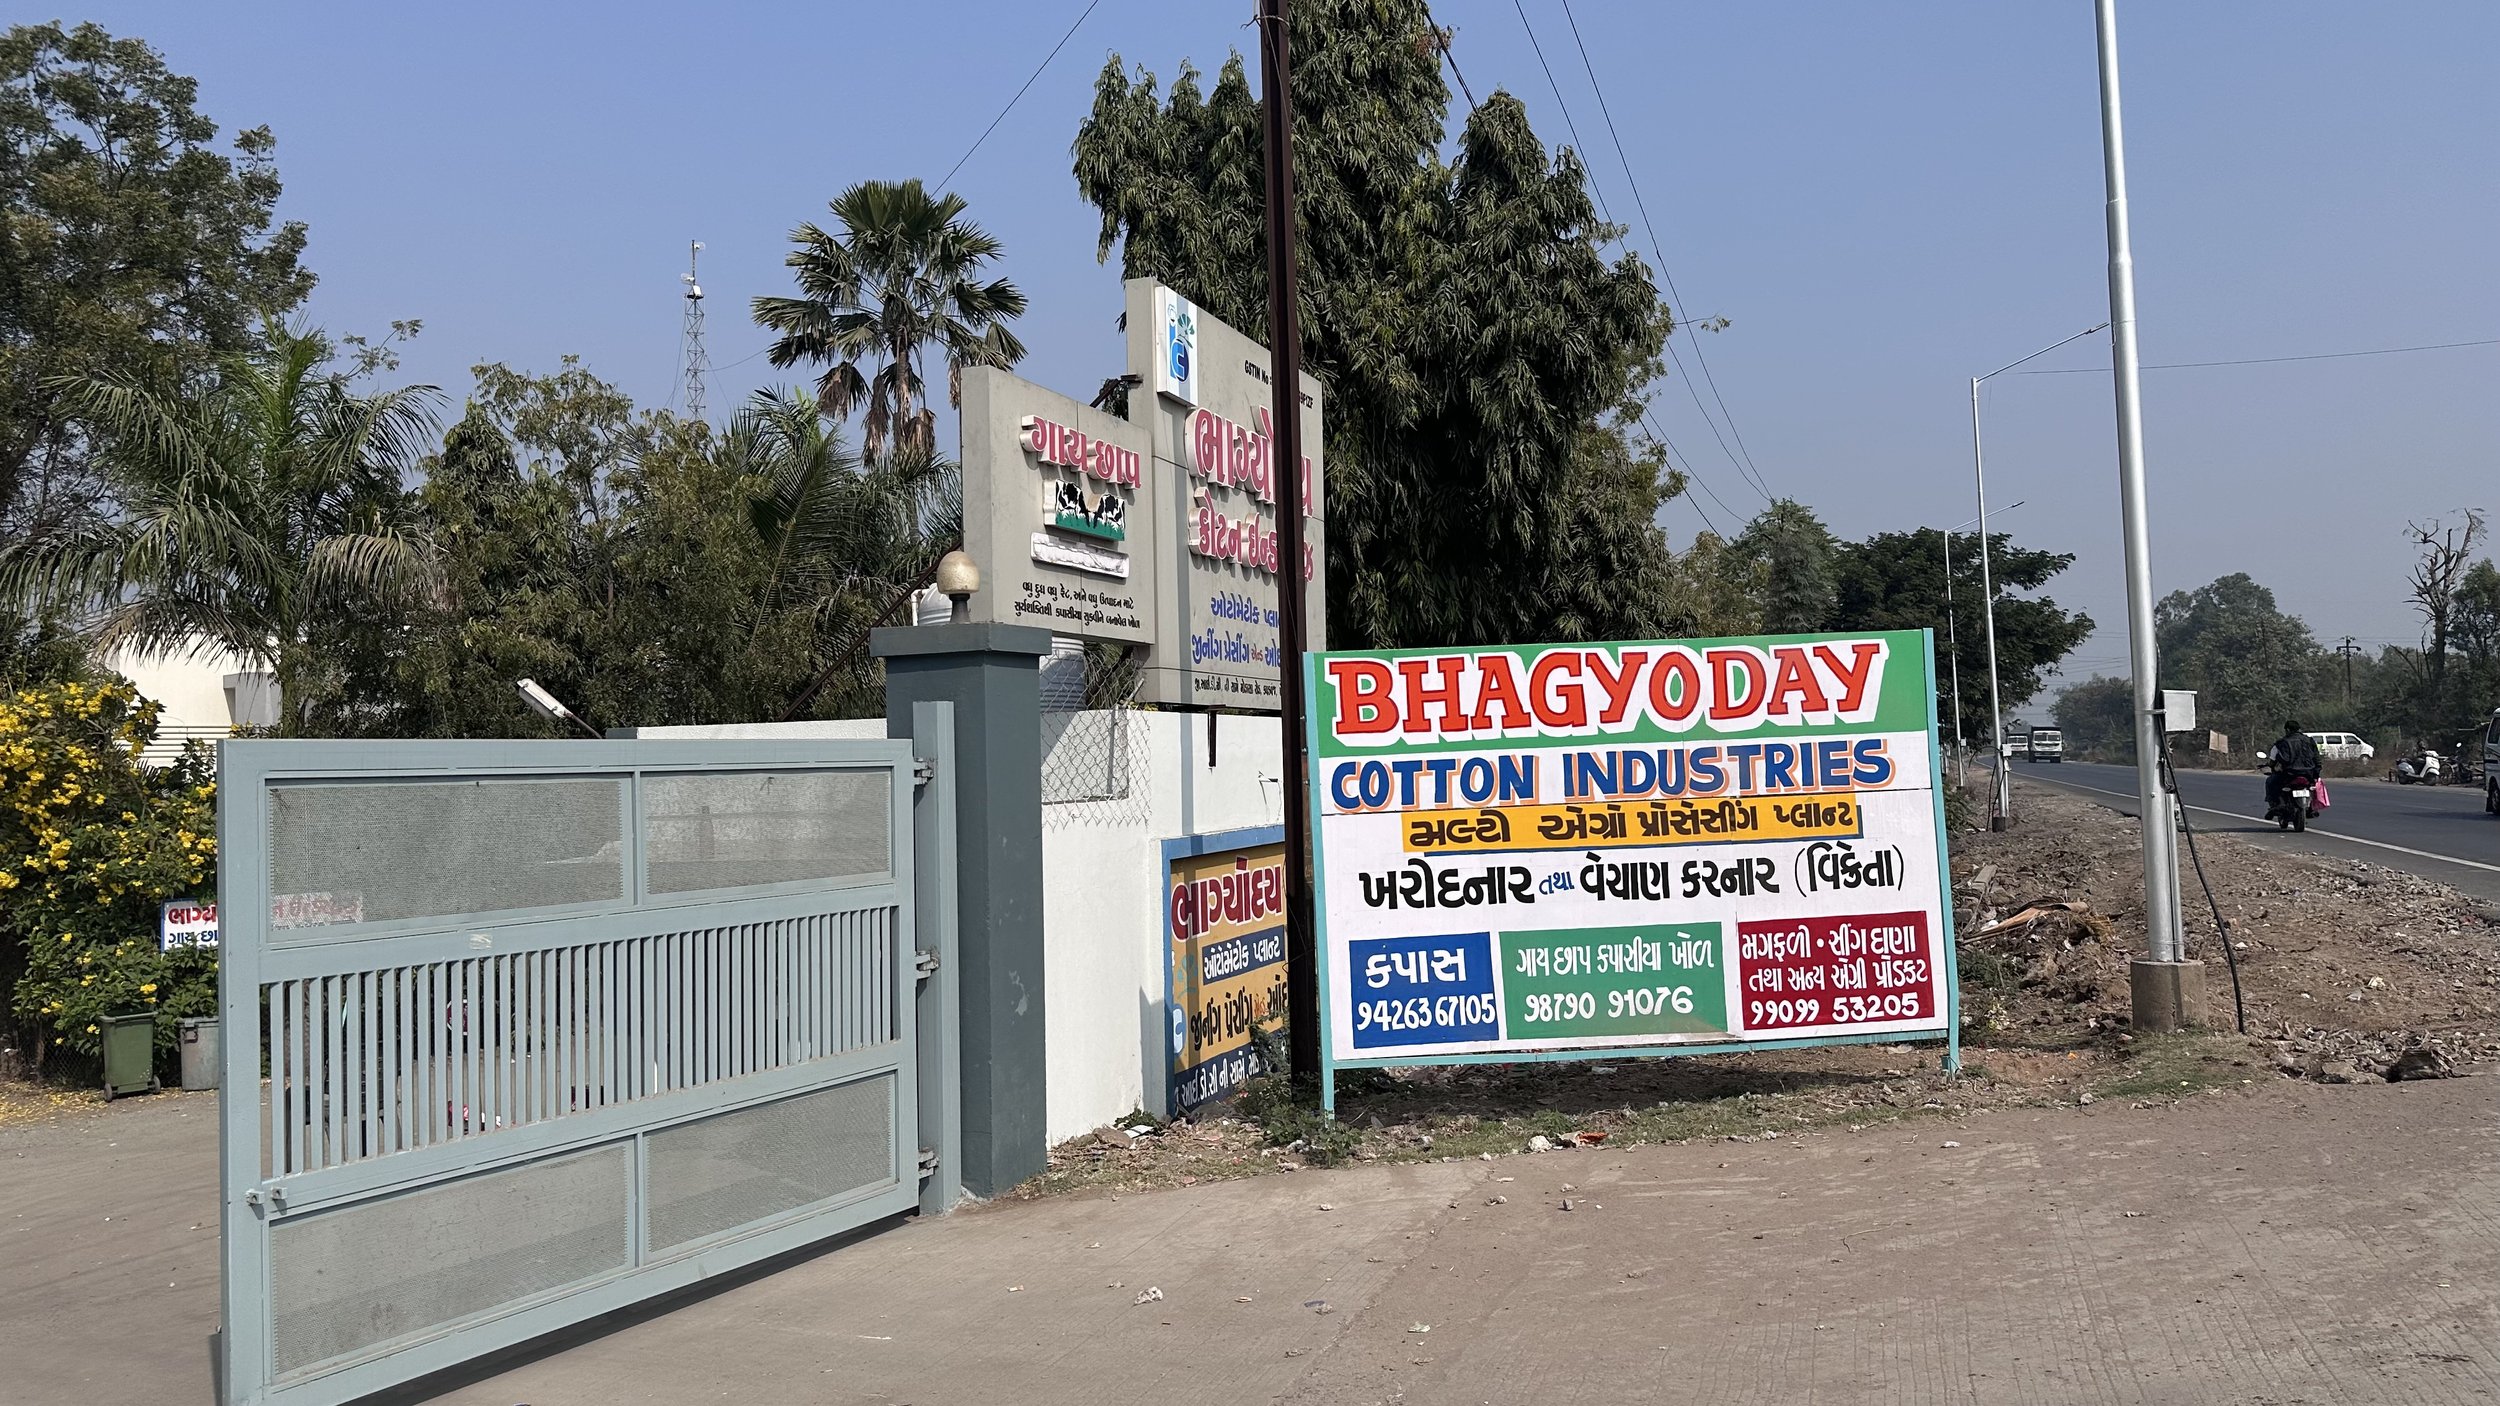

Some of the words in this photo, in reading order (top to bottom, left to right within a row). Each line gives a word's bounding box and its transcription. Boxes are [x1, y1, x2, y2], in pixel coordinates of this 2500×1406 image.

[1244, 360, 1261, 381] GSTIN
[1030, 415, 1089, 474] ગાય
[1095, 439, 1141, 489] છાપ
[1199, 489, 1242, 564] કોટન
[1211, 590, 1260, 625] ઓટોમેટીક
[1191, 627, 1222, 664] જીનીંગ
[1224, 630, 1250, 663] પ્રેસીંગ
[1328, 642, 1881, 736] BHAGYODAY
[1331, 754, 1539, 813] COTTON
[1562, 738, 1895, 801] INDUSTRIES
[1537, 803, 1627, 841] એગ્રો
[1637, 800, 1758, 837] પ્રોસેસીંગ
[1773, 801, 1854, 829] પ્લાન્ટ
[1171, 856, 1283, 942] ભાગ્યોદય
[1358, 857, 1536, 910] ખરીદનાર
[1538, 870, 1575, 896] તથા
[1580, 851, 1671, 901] વેચાણ
[1680, 857, 1781, 899] કરનાર
[201, 930, 218, 942] છા
[1515, 947, 1550, 977] ગાય
[1553, 945, 1592, 975] છાપ
[1597, 935, 1662, 973] કપાસીયા
[1741, 924, 1812, 962] મગફળી
[1203, 939, 1249, 979] ઓટોમેટીક
[1253, 935, 1281, 962] પ્લાન્ટ
[1365, 947, 1467, 989] કપાસ
[1749, 967, 1783, 992] તથા
[1787, 964, 1825, 991] અન્ય
[1524, 991, 1596, 1023] 98790
[1607, 985, 1694, 1019] 91076
[1751, 998, 1820, 1025] 99099
[1831, 992, 1920, 1023] 53205
